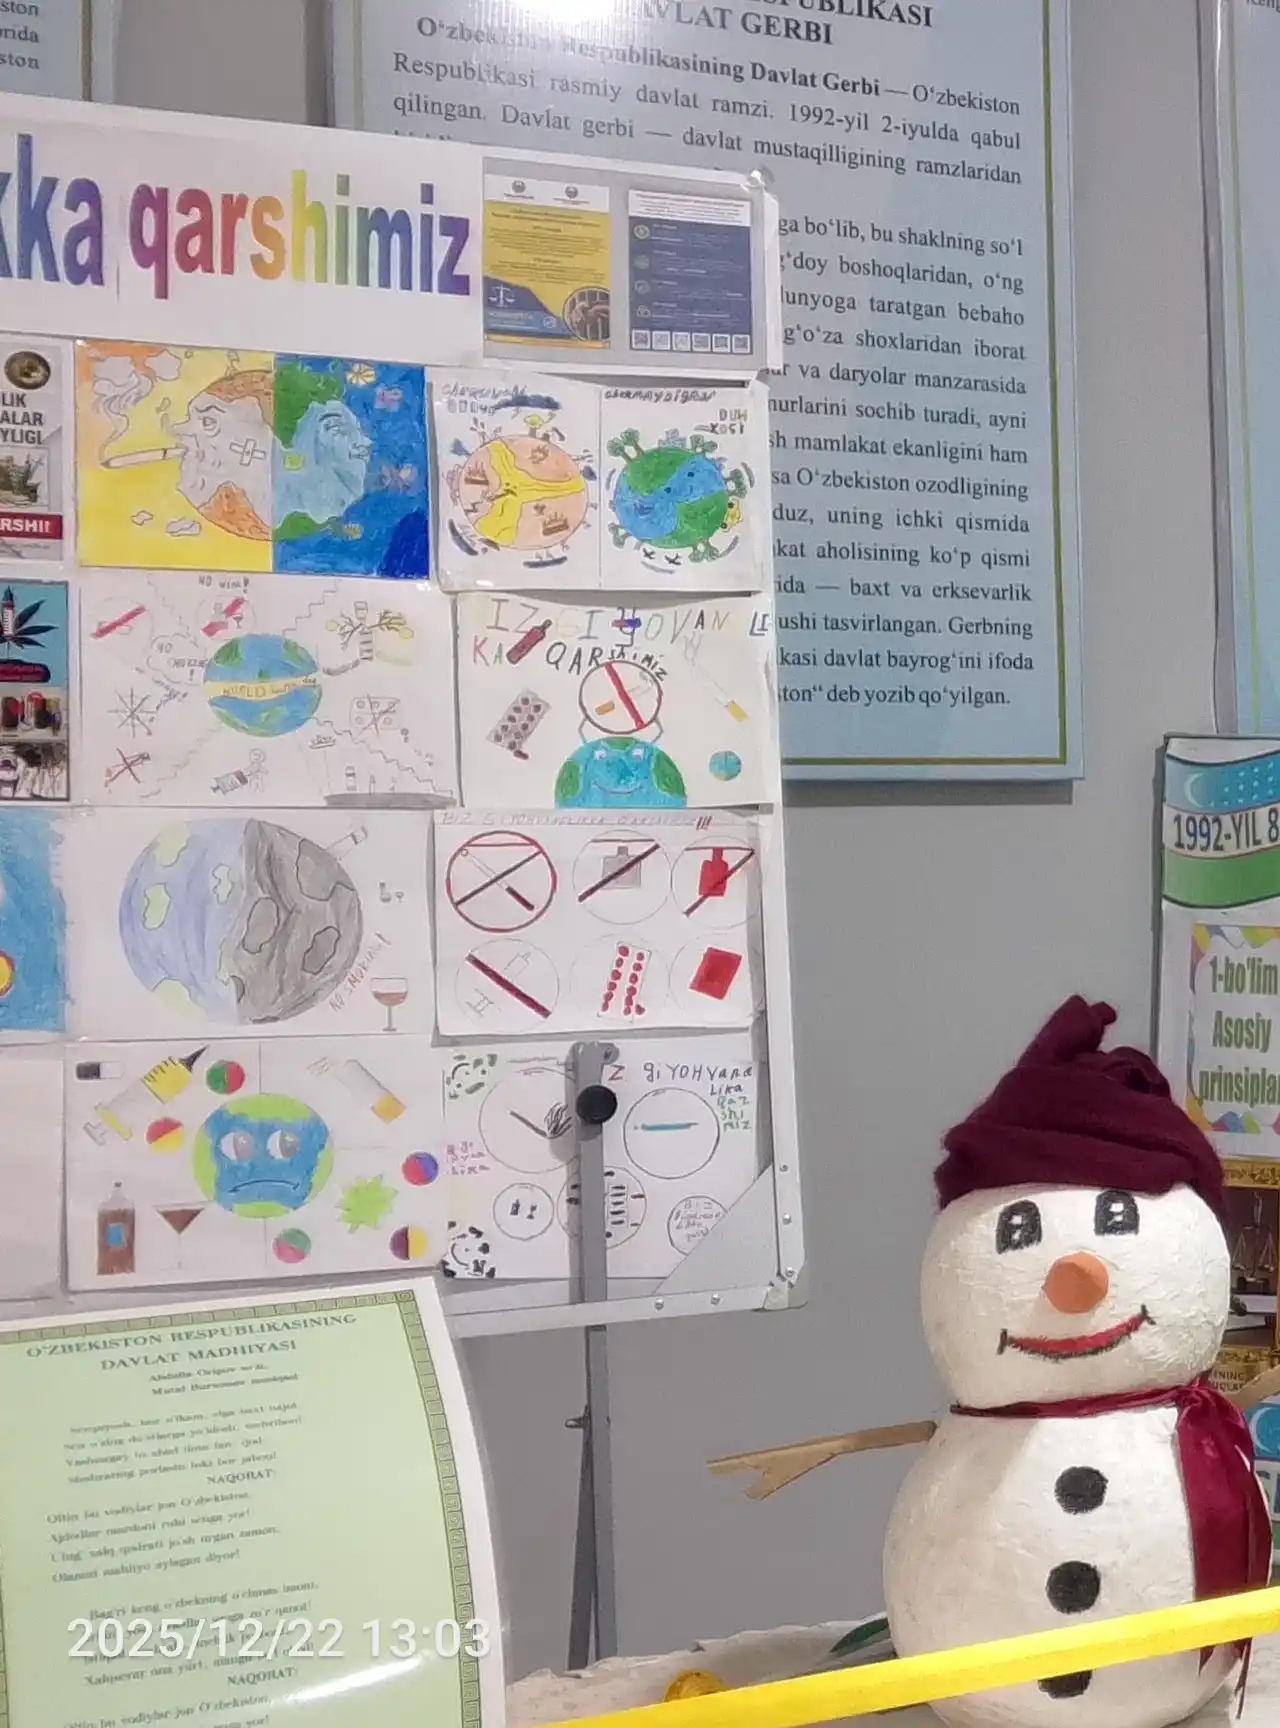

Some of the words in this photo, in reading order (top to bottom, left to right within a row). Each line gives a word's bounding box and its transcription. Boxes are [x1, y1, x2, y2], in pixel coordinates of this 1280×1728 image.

[741, 12, 833, 45] GERBI
[393, 52, 538, 89] Respublikasi
[551, 77, 622, 103] rasmiy
[636, 84, 700, 109] davlat
[711, 99, 774, 119] ramzi.
[791, 104, 869, 133] 1992-yil
[881, 115, 959, 142] 2-iyulda
[971, 129, 1021, 150] qabul
[751, 61, 818, 88] Davlat
[823, 73, 880, 96] Gerbi
[913, 84, 1021, 115] O‘zbekiston
[393, 93, 486, 122] qilingan.
[502, 105, 571, 130] Davlat
[583, 117, 634, 138] gerbi
[682, 127, 742, 151] davlat
[754, 140, 906, 175] mustaqilligining
[916, 160, 1022, 185] ramzlaridan
[129, 169, 470, 300] qarshimiz
[804, 216, 865, 242] bo‘lib,
[871, 223, 893, 242] bu
[899, 227, 985, 256] shaklning
[990, 239, 1022, 256] so‘l
[839, 255, 972, 289] boshoqlaridan,
[984, 272, 1024, 295] o‘ng
[869, 296, 946, 320] taratgan
[958, 302, 1024, 326] bebaho
[783, 318, 844, 346] g‘o‘za
[856, 329, 962, 355] shoxlaridan
[974, 339, 1027, 360] iborat
[856, 402, 915, 421] sochib
[924, 407, 981, 428] turadi,
[989, 412, 1026, 432] ayni
[797, 468, 909, 491] O‘zbekiston
[916, 477, 1028, 502] ozodligining
[817, 541, 920, 567] aholisining
[930, 545, 971, 569] ko‘p
[981, 549, 1030, 570] qismi
[850, 578, 890, 597] baxt
[901, 585, 922, 598] va
[932, 581, 1032, 601] erksevarlik
[823, 614, 942, 637] tasvirlangan.
[948, 616, 1033, 640] Gerbning
[824, 648, 881, 667] davlat
[887, 650, 981, 673] bayrog‘ini
[989, 652, 1034, 670] ifoda
[827, 684, 860, 702] deb
[864, 685, 915, 707] yozib
[919, 686, 1010, 708] qo‘yilgan.
[1173, 810, 1262, 850] 1992-YIL
[1212, 1010, 1271, 1053] Asosiy
[101, 1351, 180, 1371] DAVLAT
